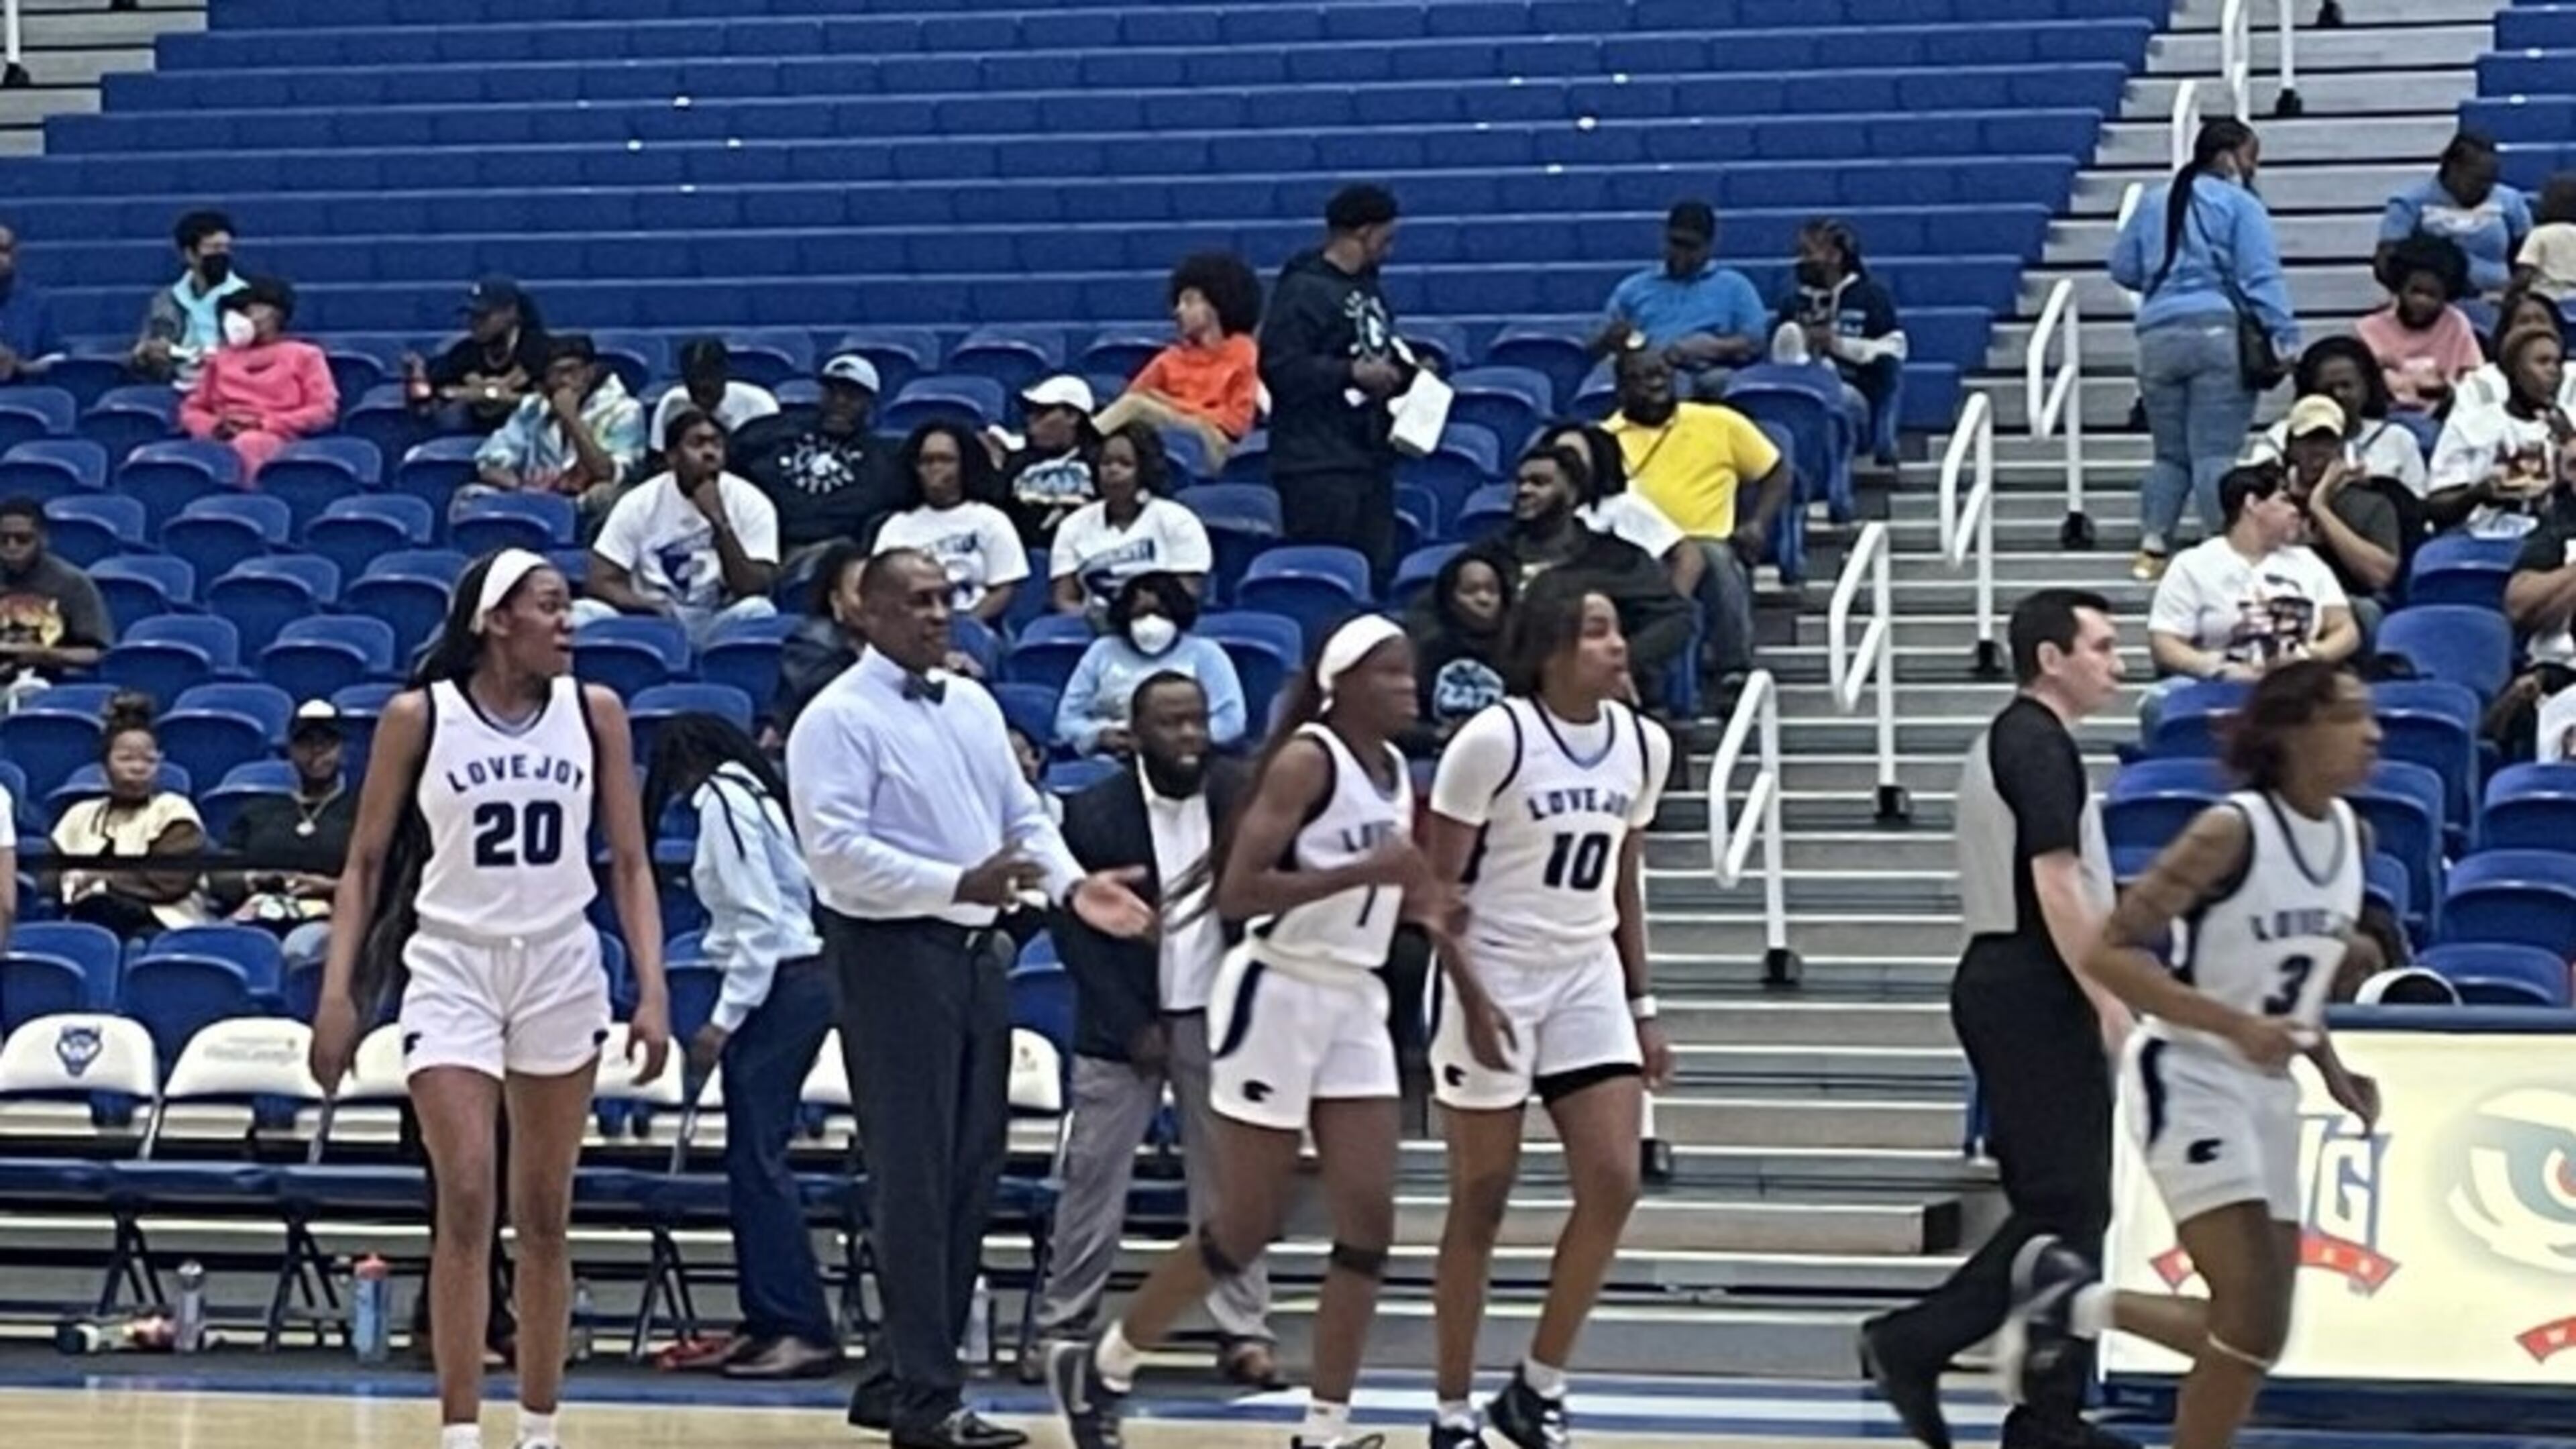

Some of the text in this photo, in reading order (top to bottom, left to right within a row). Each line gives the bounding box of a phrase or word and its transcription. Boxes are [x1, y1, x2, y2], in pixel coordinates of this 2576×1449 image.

[447, 753, 584, 793] LOVEJOY
[474, 800, 563, 867] 20
[1544, 831, 1612, 891] 10
[2262, 953, 2315, 1016] 3
